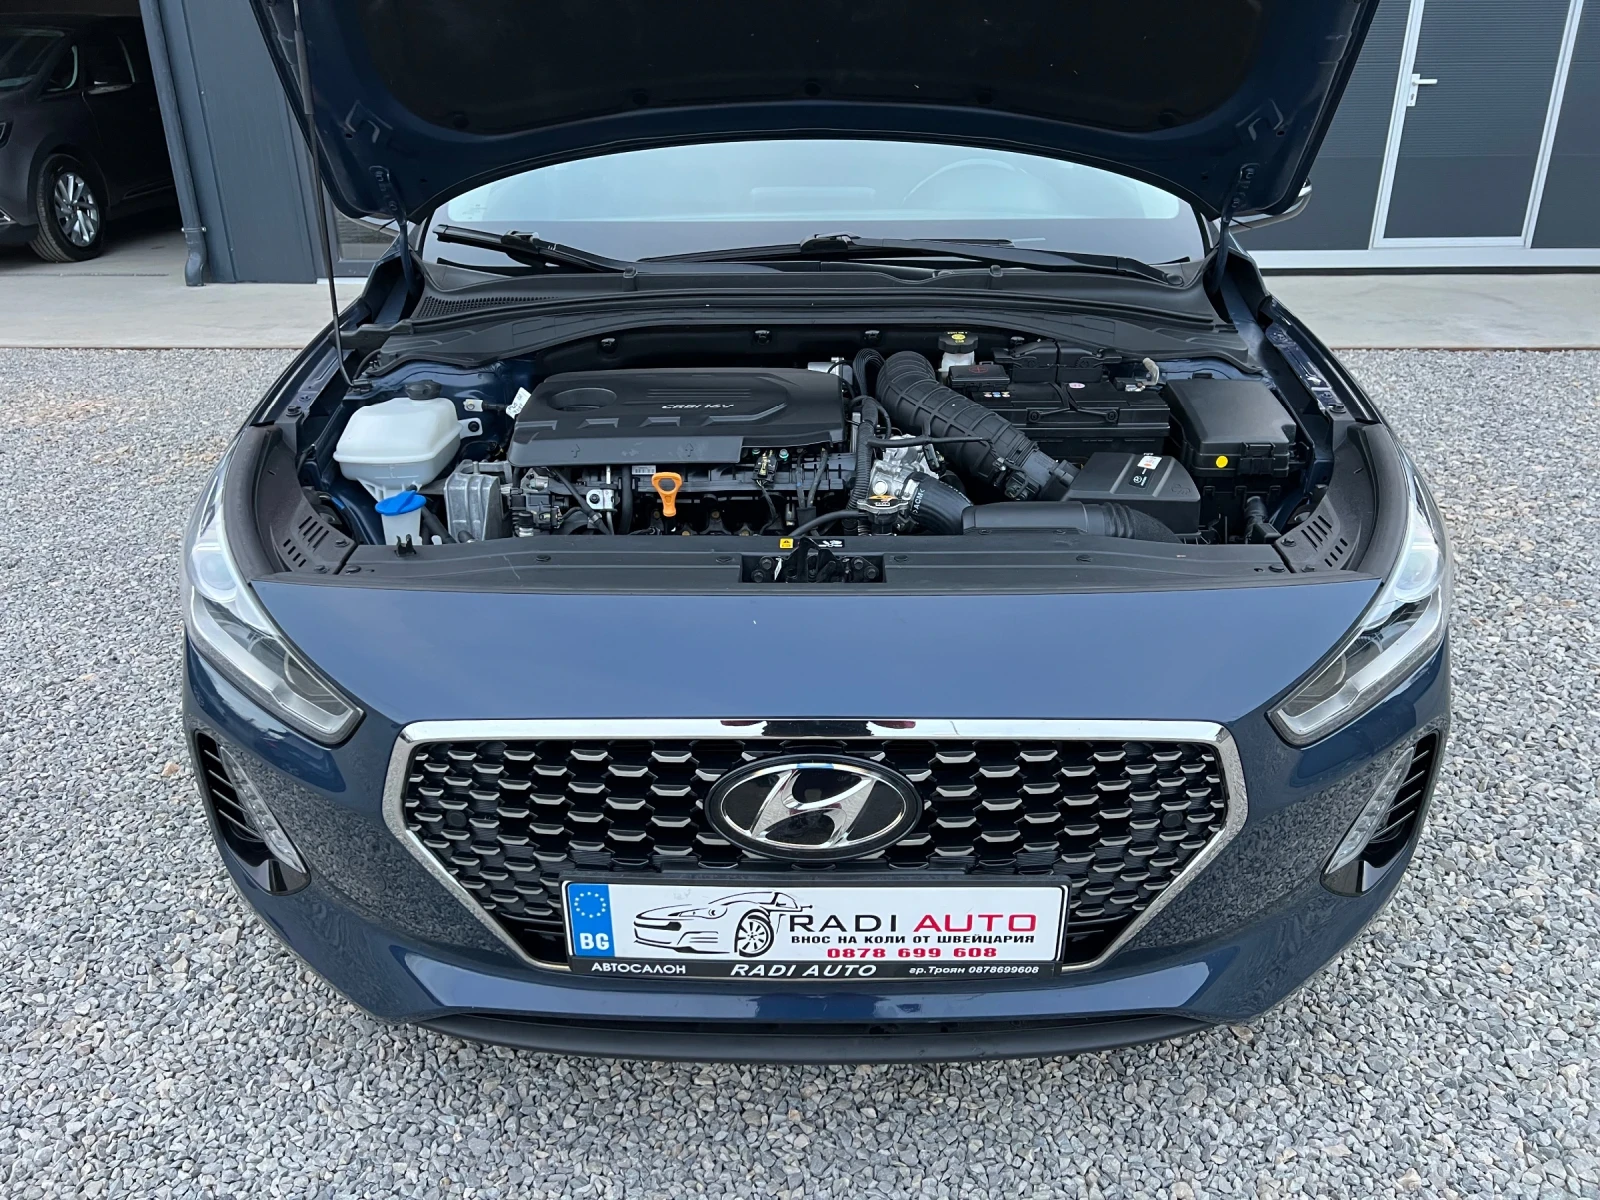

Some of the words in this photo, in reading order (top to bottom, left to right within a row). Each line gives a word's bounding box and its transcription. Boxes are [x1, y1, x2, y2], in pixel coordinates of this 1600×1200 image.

[789, 915, 897, 932] RADI
[913, 914, 1036, 932] AUTO
[580, 933, 609, 950] BG
[791, 936, 831, 944] ВНОС
[838, 936, 857, 944] НА
[864, 936, 905, 944] КОЛИ
[913, 935, 930, 944] ОТ
[937, 934, 1035, 944] ШВЕЙЦАРИЯ
[827, 948, 886, 958] 0878
[898, 948, 941, 958] 699
[953, 948, 997, 958] 608
[591, 962, 686, 974] АВТОСАЛОН
[731, 964, 796, 977] RADI
[802, 965, 877, 977] AUTO
[968, 966, 1039, 974] 0878699608
